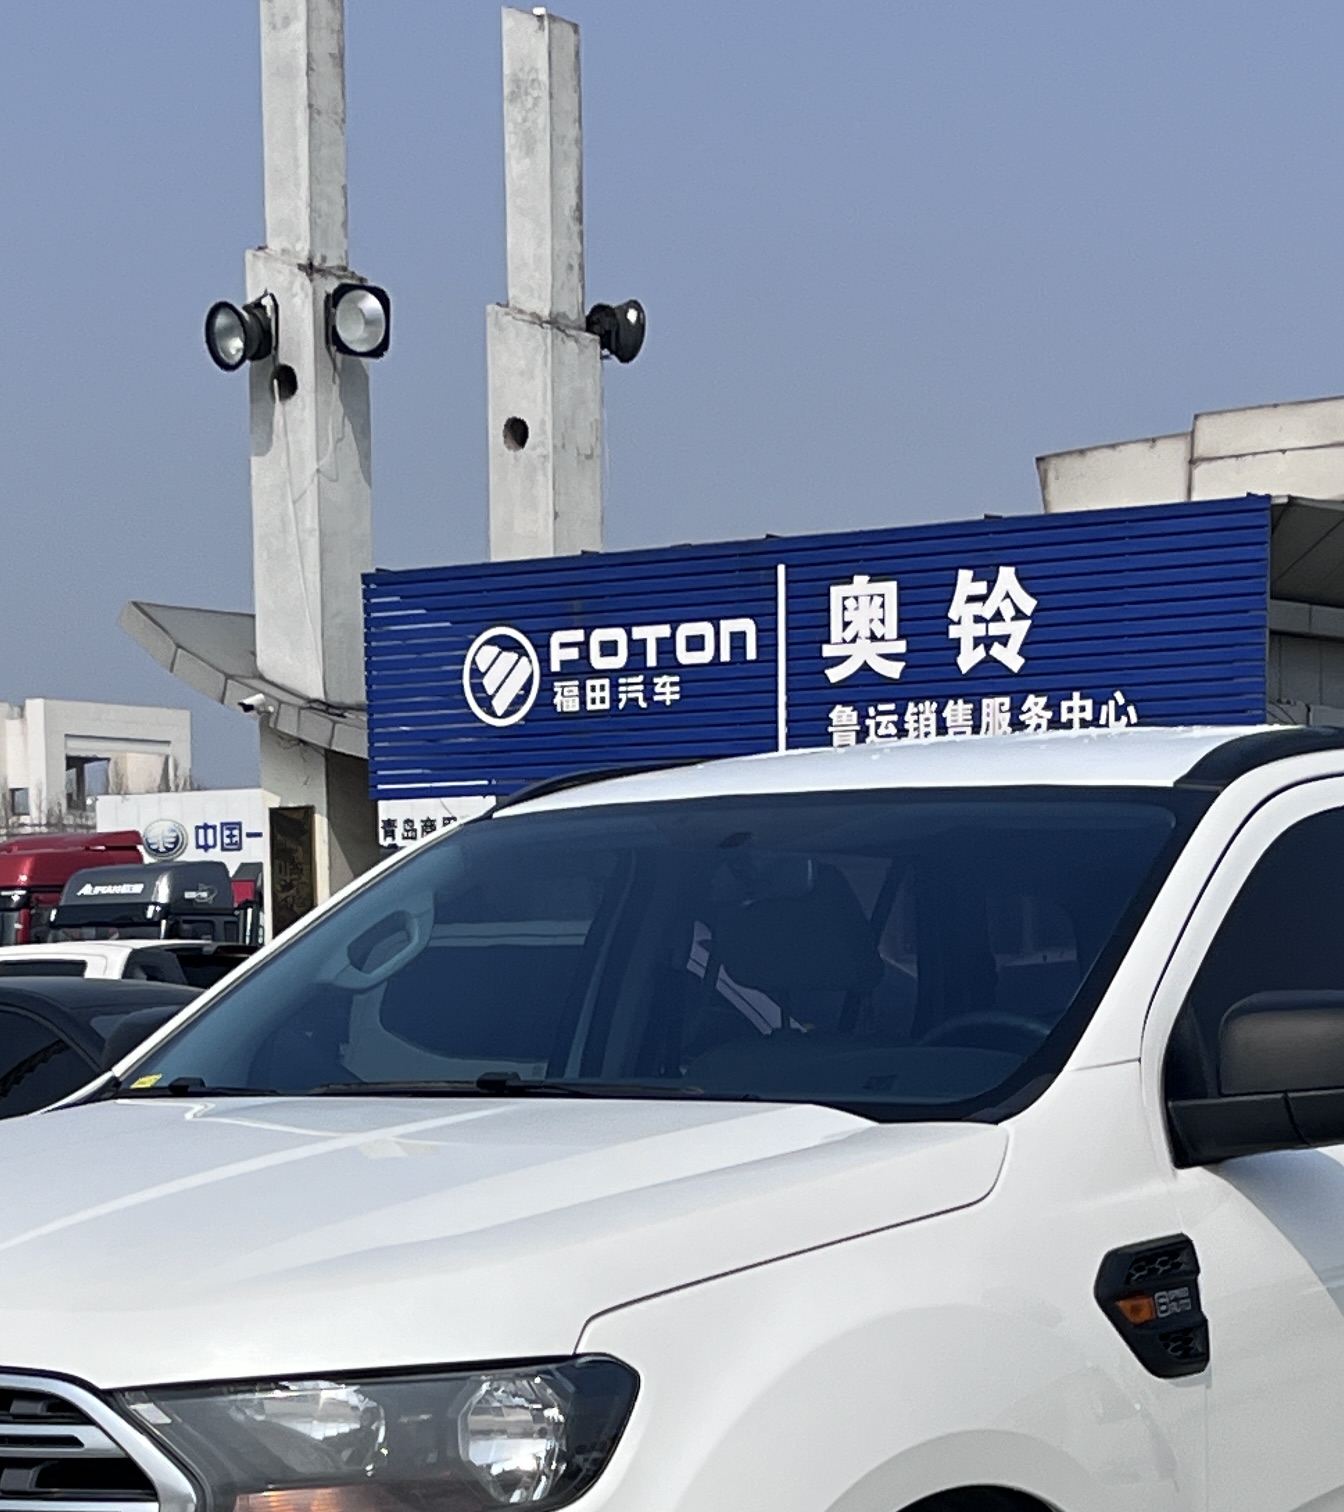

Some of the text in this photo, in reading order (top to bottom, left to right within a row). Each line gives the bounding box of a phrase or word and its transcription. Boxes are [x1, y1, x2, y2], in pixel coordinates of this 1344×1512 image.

[549, 618, 758, 672] FOTON
[822, 565, 1038, 684] 奥铃
[553, 675, 681, 713] 福田汽车
[827, 691, 1139, 747] 鲁运销售服务中心
[1155, 1291, 1172, 1318] 6
